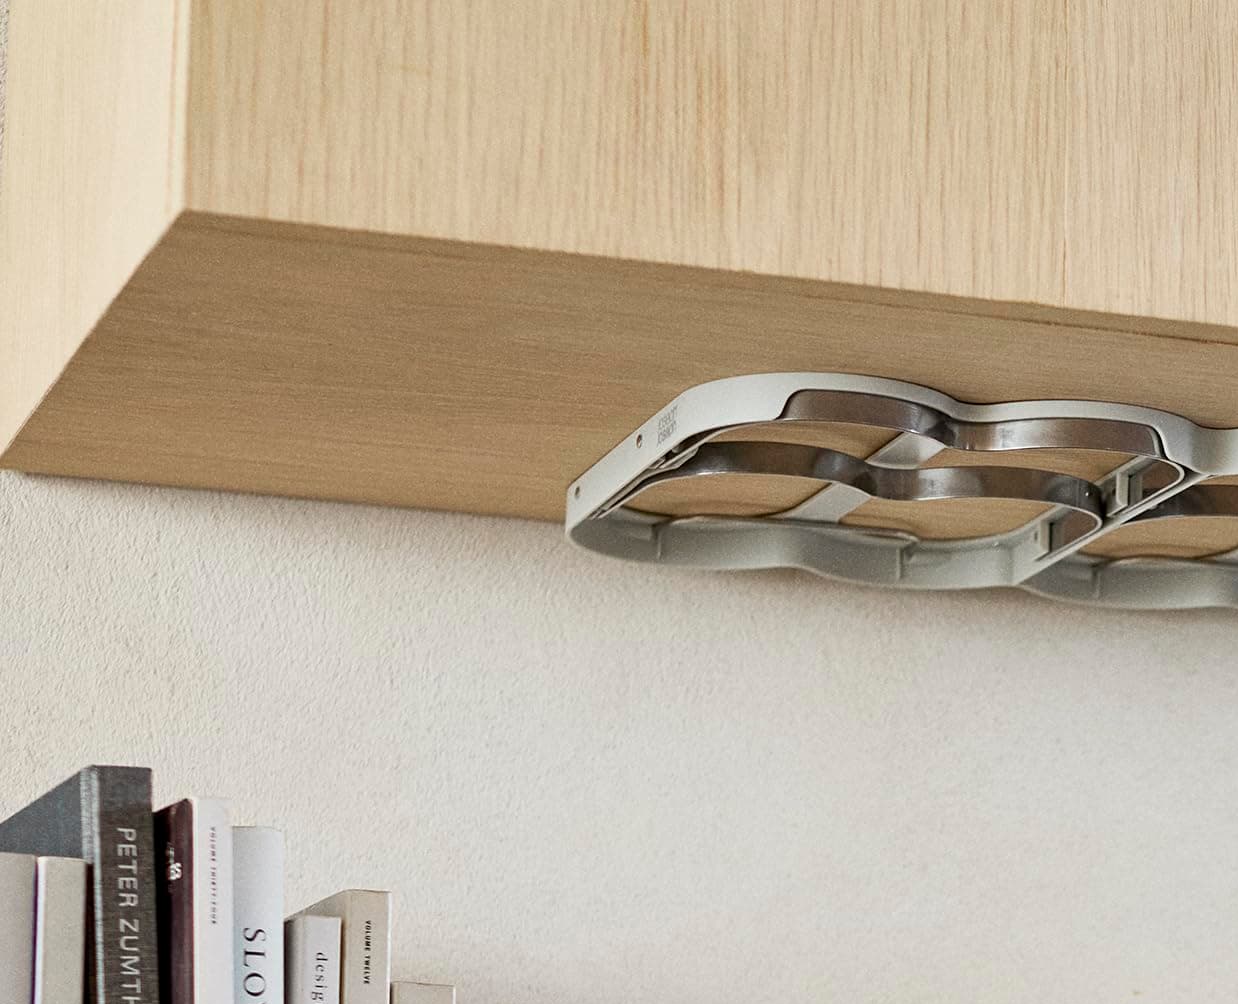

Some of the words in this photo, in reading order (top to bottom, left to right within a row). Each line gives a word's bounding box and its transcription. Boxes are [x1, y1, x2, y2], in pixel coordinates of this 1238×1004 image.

[116, 827, 139, 907] PETER
[364, 920, 372, 951] VOLUME
[363, 955, 371, 985] TWELVE
